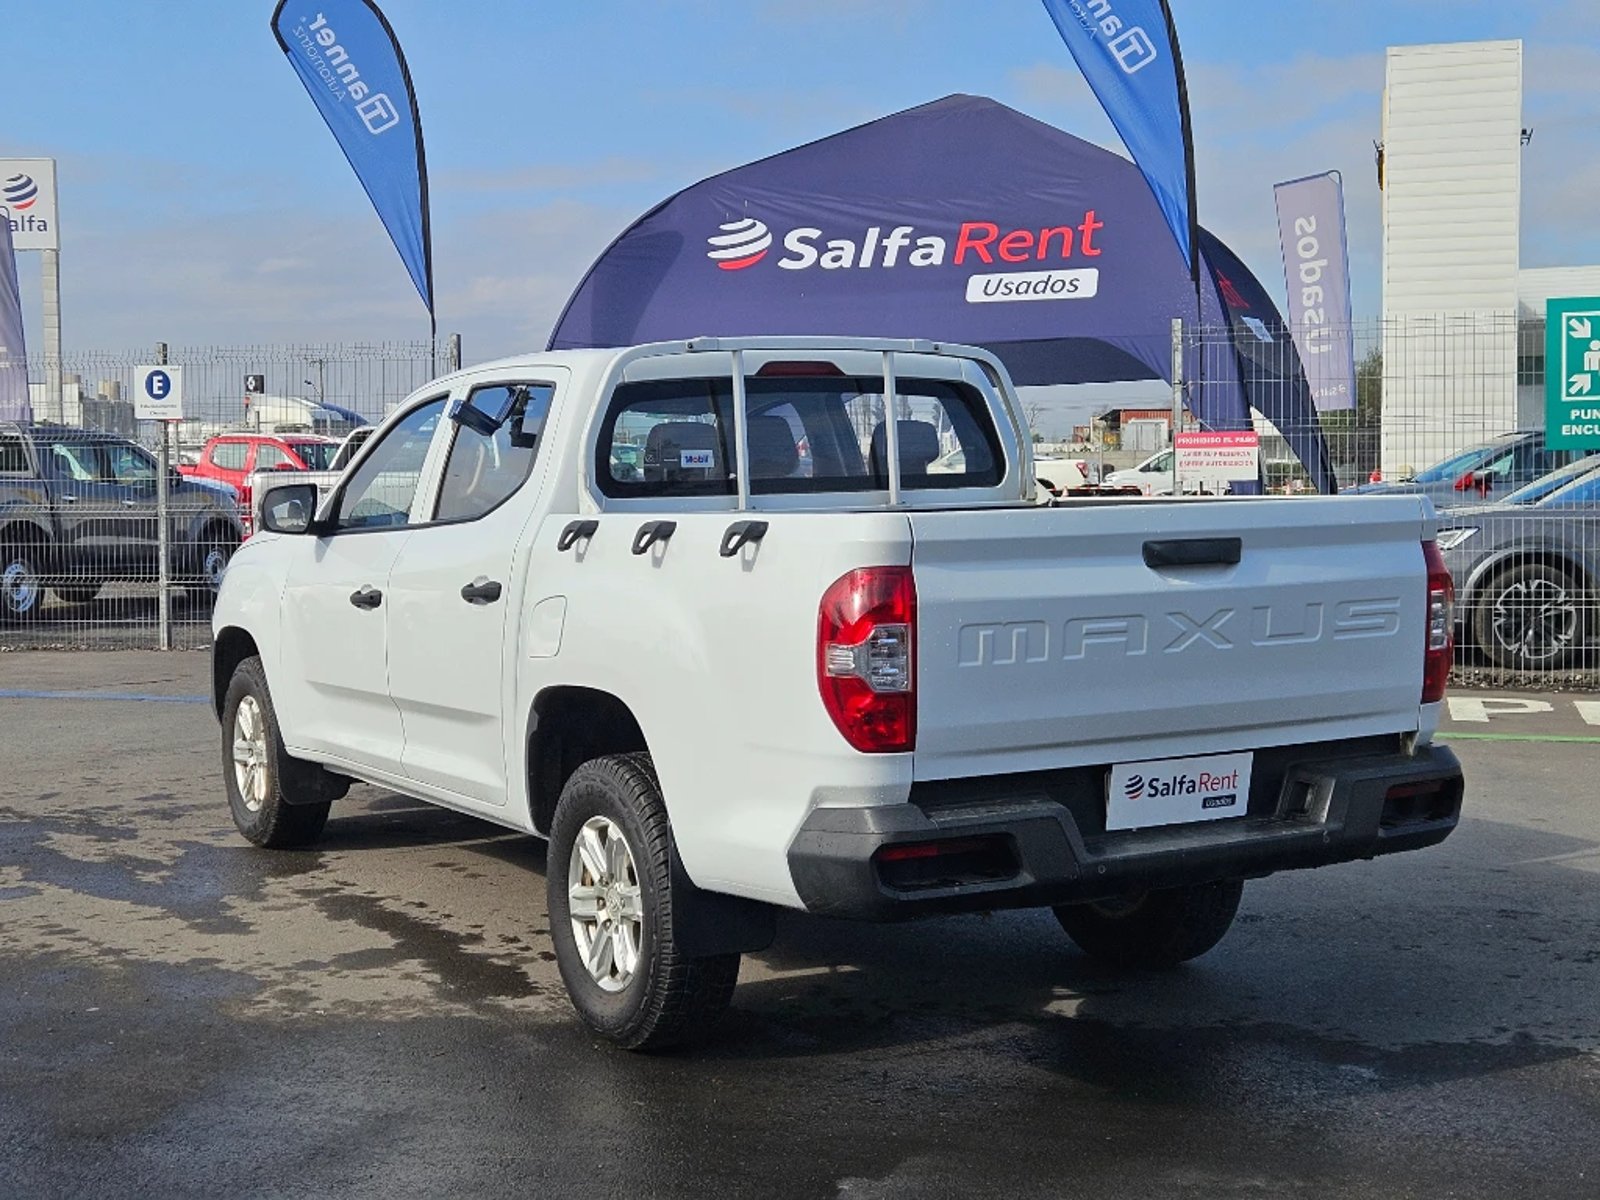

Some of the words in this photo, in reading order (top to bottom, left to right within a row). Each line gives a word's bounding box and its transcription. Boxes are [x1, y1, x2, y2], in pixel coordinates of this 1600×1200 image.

[9, 215, 48, 232] alfa
[982, 273, 1081, 297] Usados
[152, 375, 164, 395] E
[684, 454, 709, 464] Mobil
[958, 597, 1400, 668] MAXUS
